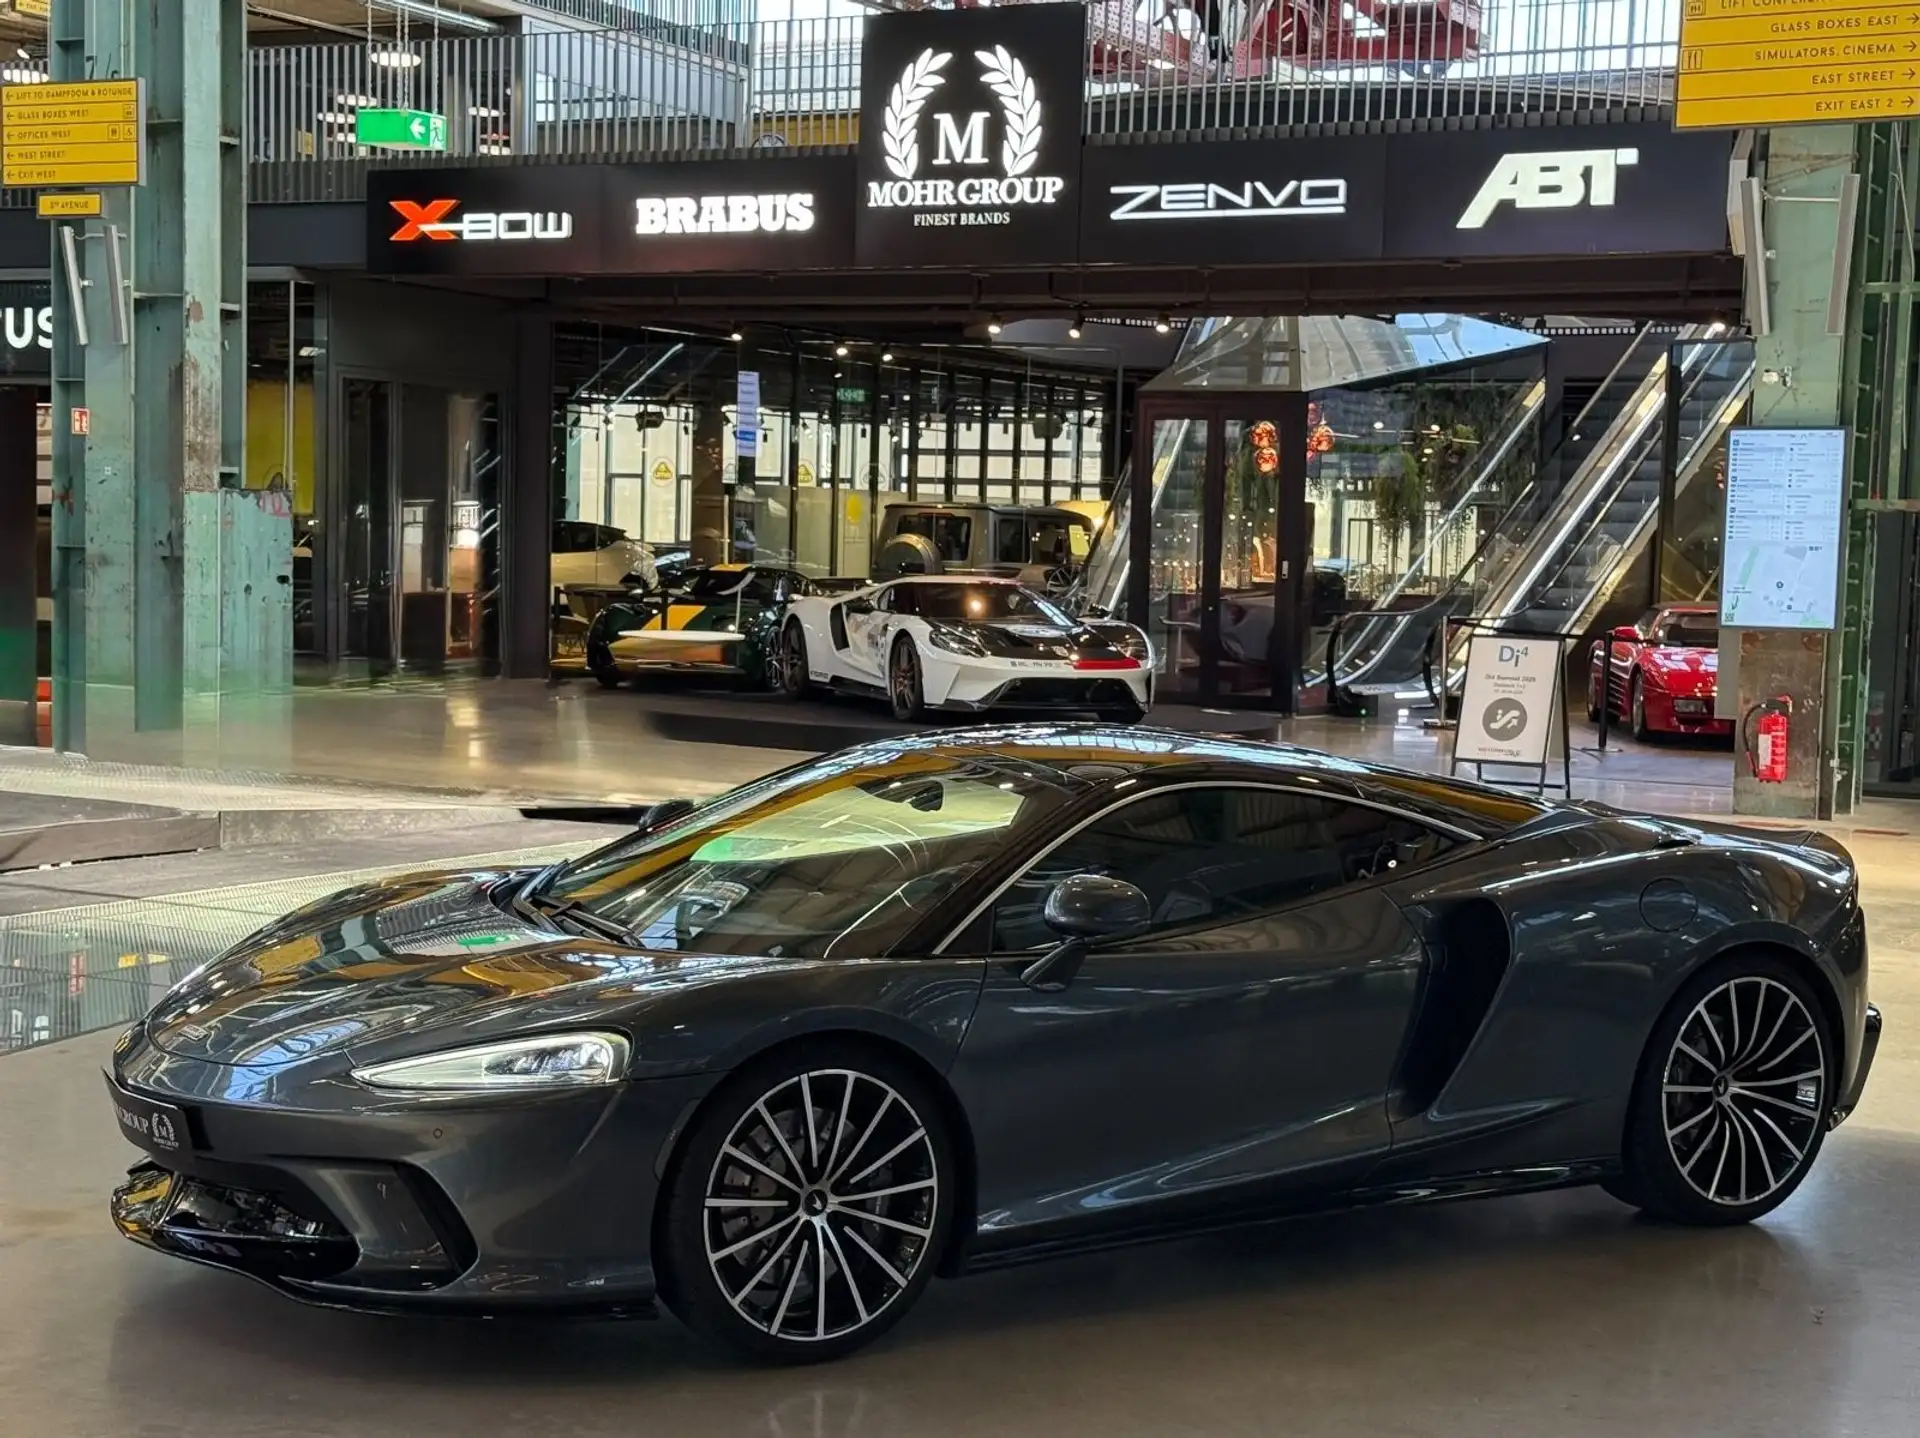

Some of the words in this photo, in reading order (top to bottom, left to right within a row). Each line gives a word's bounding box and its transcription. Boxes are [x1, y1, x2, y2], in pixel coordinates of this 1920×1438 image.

[1770, 21, 1811, 33] GLASS
[1817, 18, 1861, 29] BOXES
[1867, 15, 1899, 26] EAST
[1843, 44, 1896, 55] CINEMA
[1811, 73, 1842, 85] EAST
[1848, 70, 1896, 83] STREET
[34, 91, 43, 99] TO
[1815, 101, 1844, 112] EXIT
[1850, 99, 1881, 110] EAST
[1886, 98, 1894, 108] 2
[42, 110, 67, 119] BOXES
[68, 108, 89, 117] WEST
[17, 130, 48, 140] OFFICES
[51, 129, 71, 139] WEST
[932, 111, 991, 165] M
[18, 151, 36, 160] WEST
[36, 169, 56, 179] WEST
[867, 180, 957, 208] MOHR
[957, 176, 1065, 206] GROUP
[1455, 147, 1639, 229] ABT
[1110, 179, 1347, 220] ZENVO
[635, 193, 815, 235] BRABUS
[913, 213, 957, 227] FINEST
[960, 211, 1011, 226] BRANDS
[0, 306, 53, 349] US
